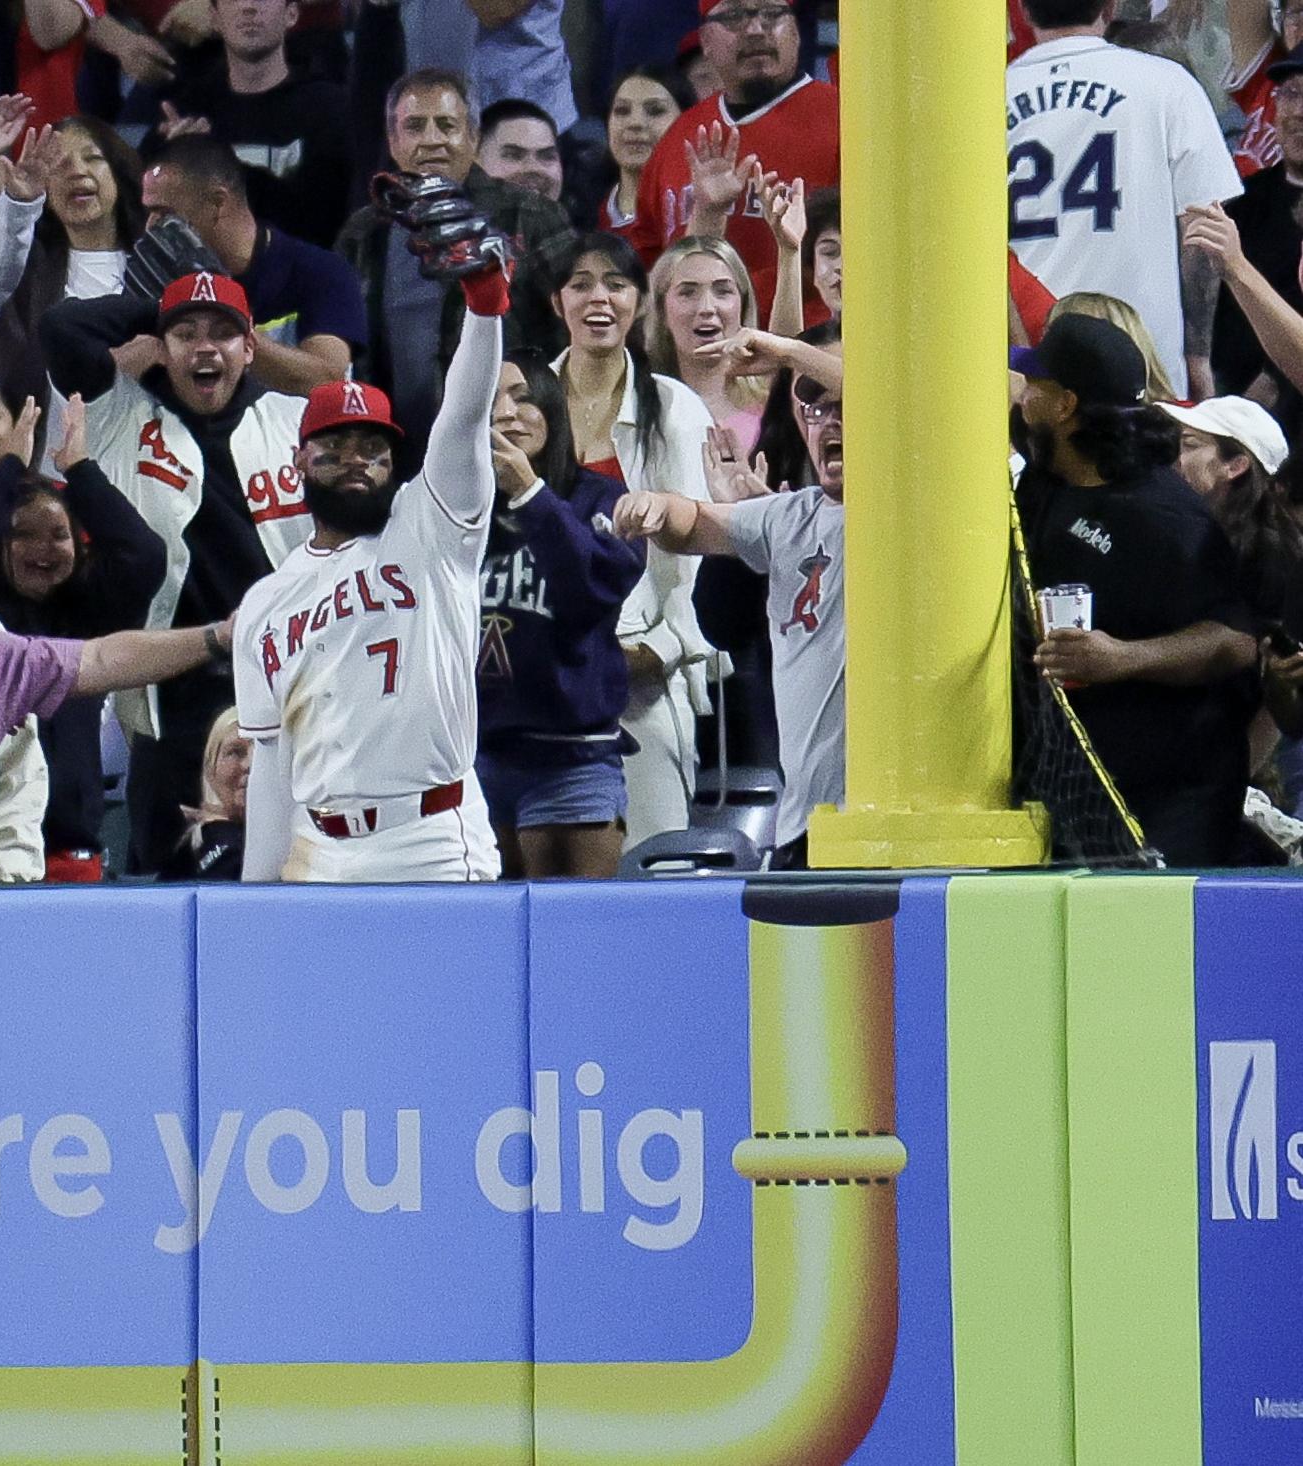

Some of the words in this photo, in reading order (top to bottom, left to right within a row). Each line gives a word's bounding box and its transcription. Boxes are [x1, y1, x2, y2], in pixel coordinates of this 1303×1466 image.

[1007, 129, 1123, 243] 24
[191, 271, 216, 302] A
[340, 381, 369, 416] A
[259, 564, 416, 692] ANGELS
[365, 637, 402, 697] 7
[153, 1107, 423, 1255] you
[474, 1060, 705, 1250] dig
